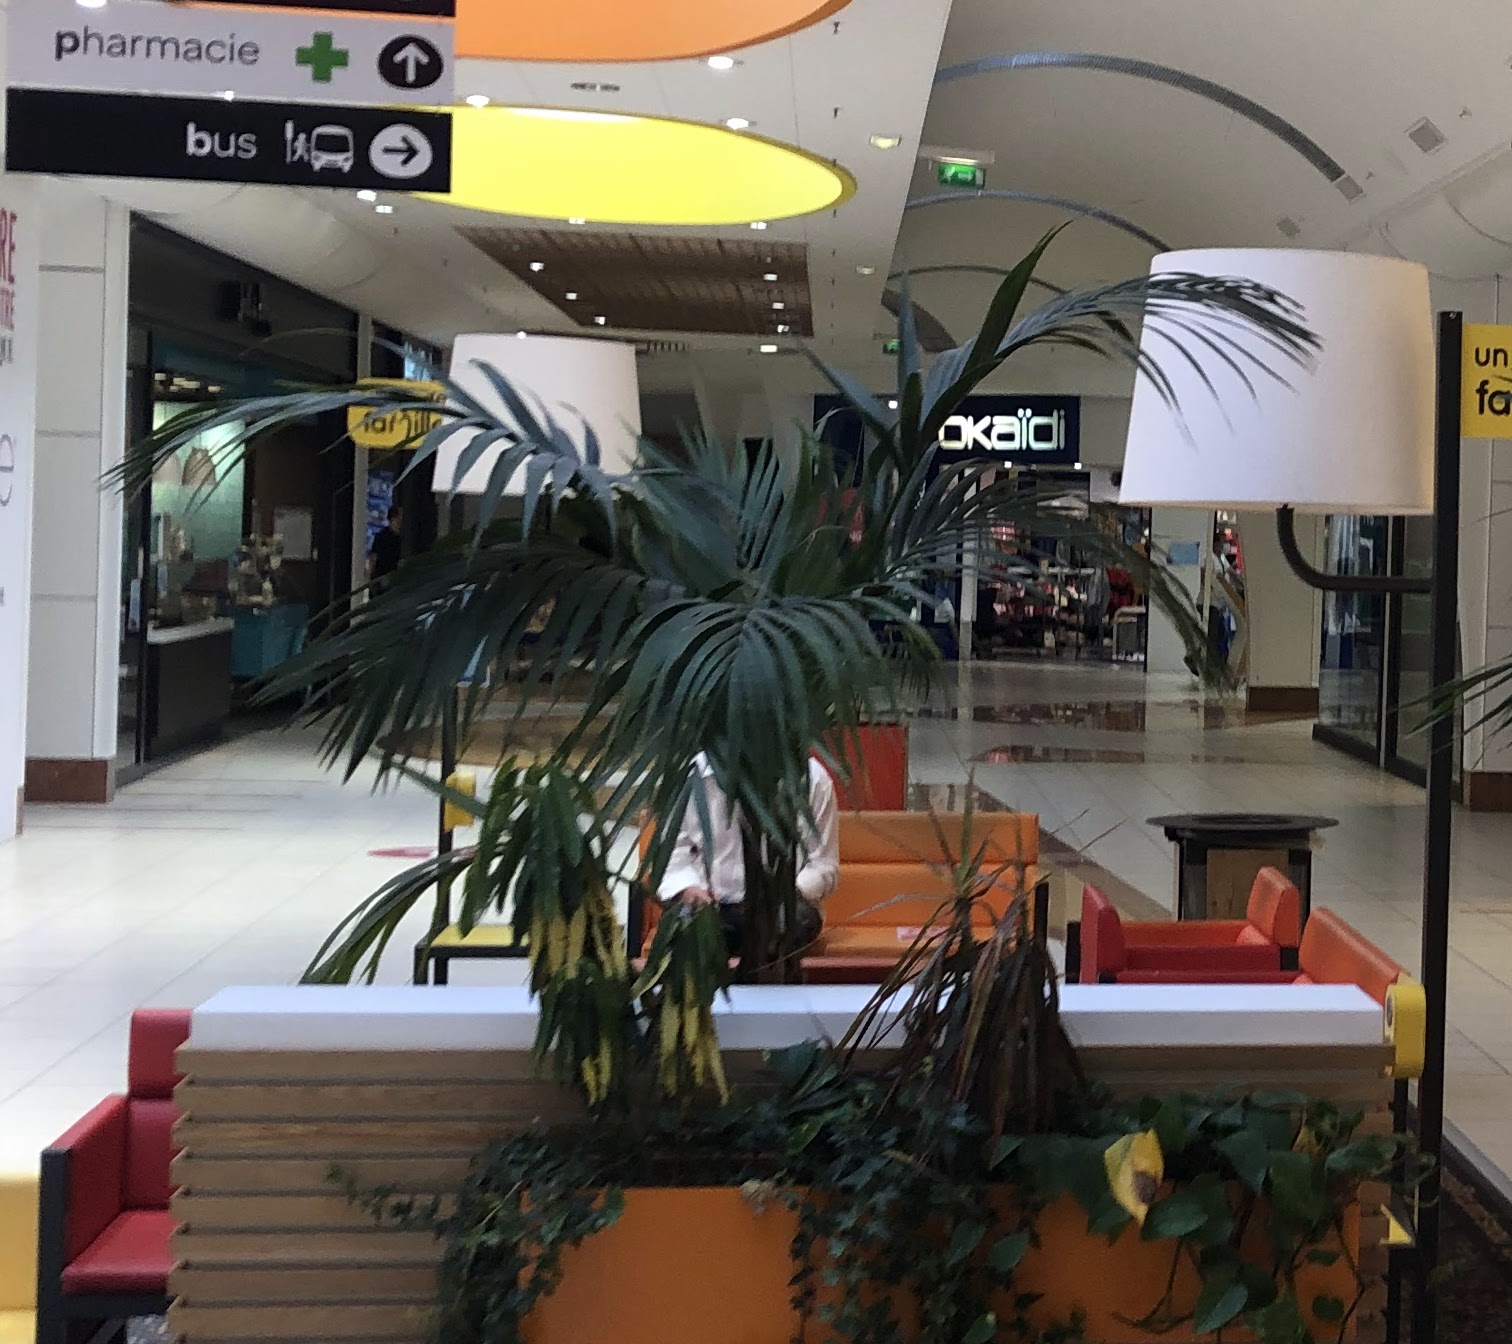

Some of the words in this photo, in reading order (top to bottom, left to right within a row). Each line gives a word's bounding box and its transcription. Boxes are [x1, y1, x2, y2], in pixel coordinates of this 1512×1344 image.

[54, 25, 260, 66] pharmacie
[185, 121, 258, 159] bus
[1474, 346, 1509, 368] un
[937, 407, 1066, 451] okaïdi
